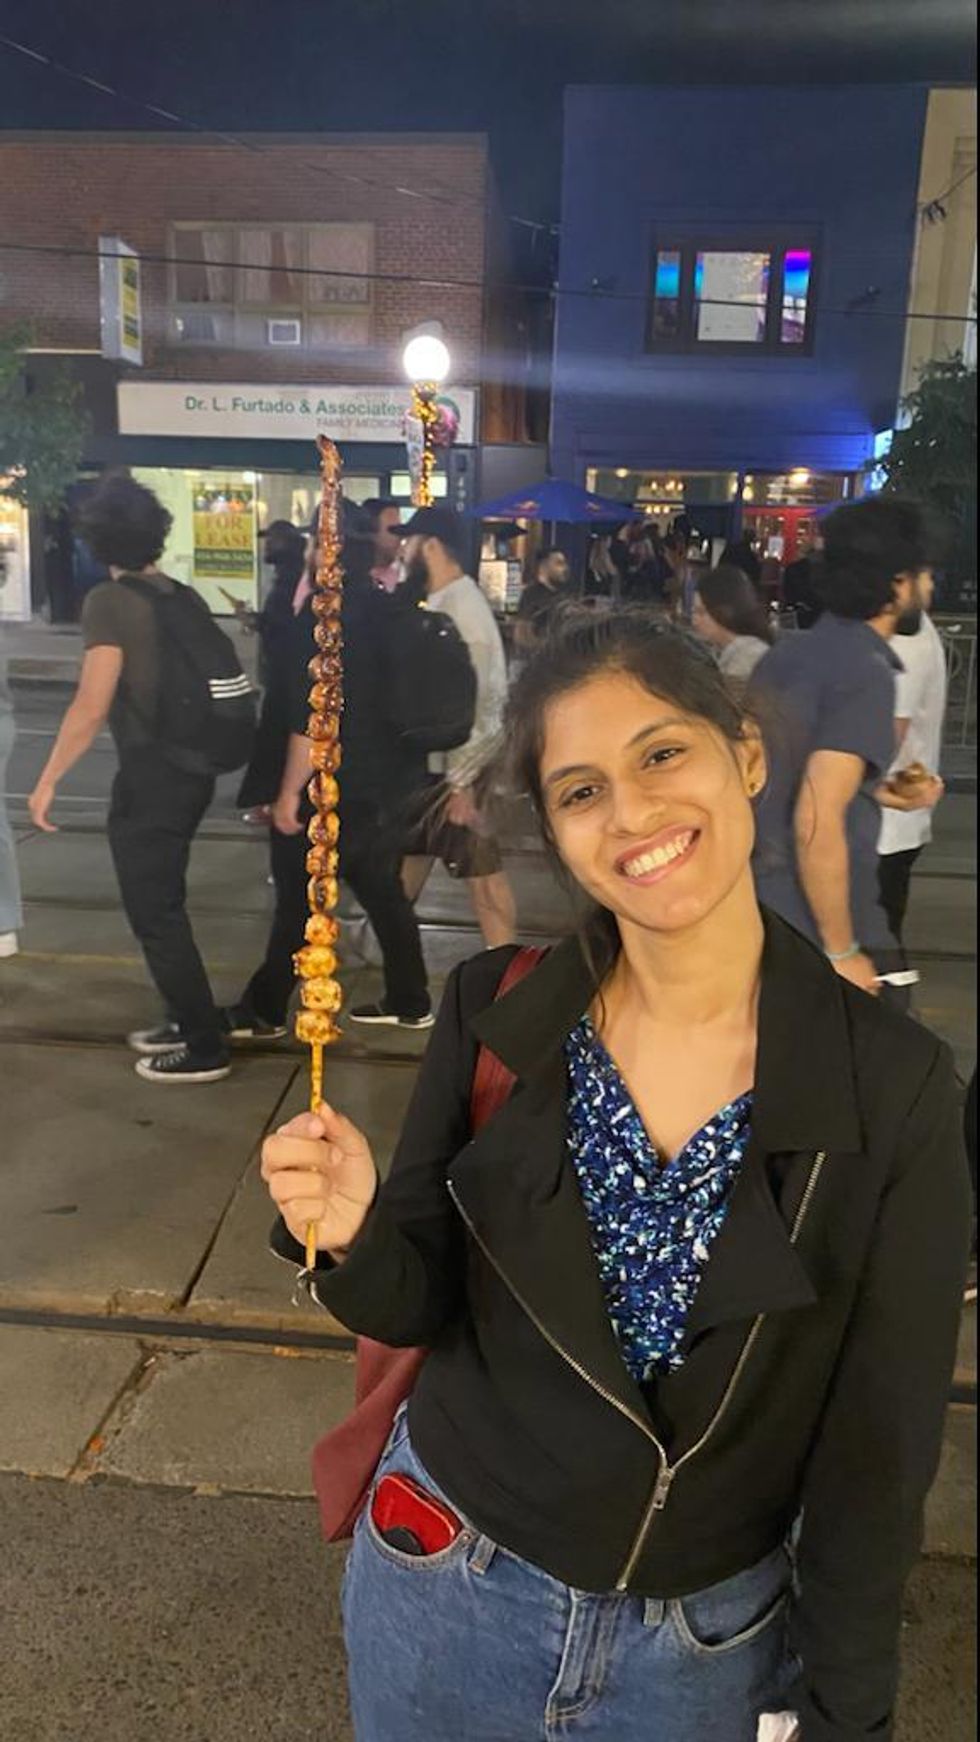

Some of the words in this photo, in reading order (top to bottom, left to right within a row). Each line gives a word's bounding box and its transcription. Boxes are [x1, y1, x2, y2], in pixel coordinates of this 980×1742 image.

[184, 395, 208, 411] Dr.
[212, 396, 227, 412] L.
[231, 396, 295, 414] Furtado
[299, 399, 311, 414] &
[315, 400, 405, 417] Associates
[204, 515, 244, 530] FOR
